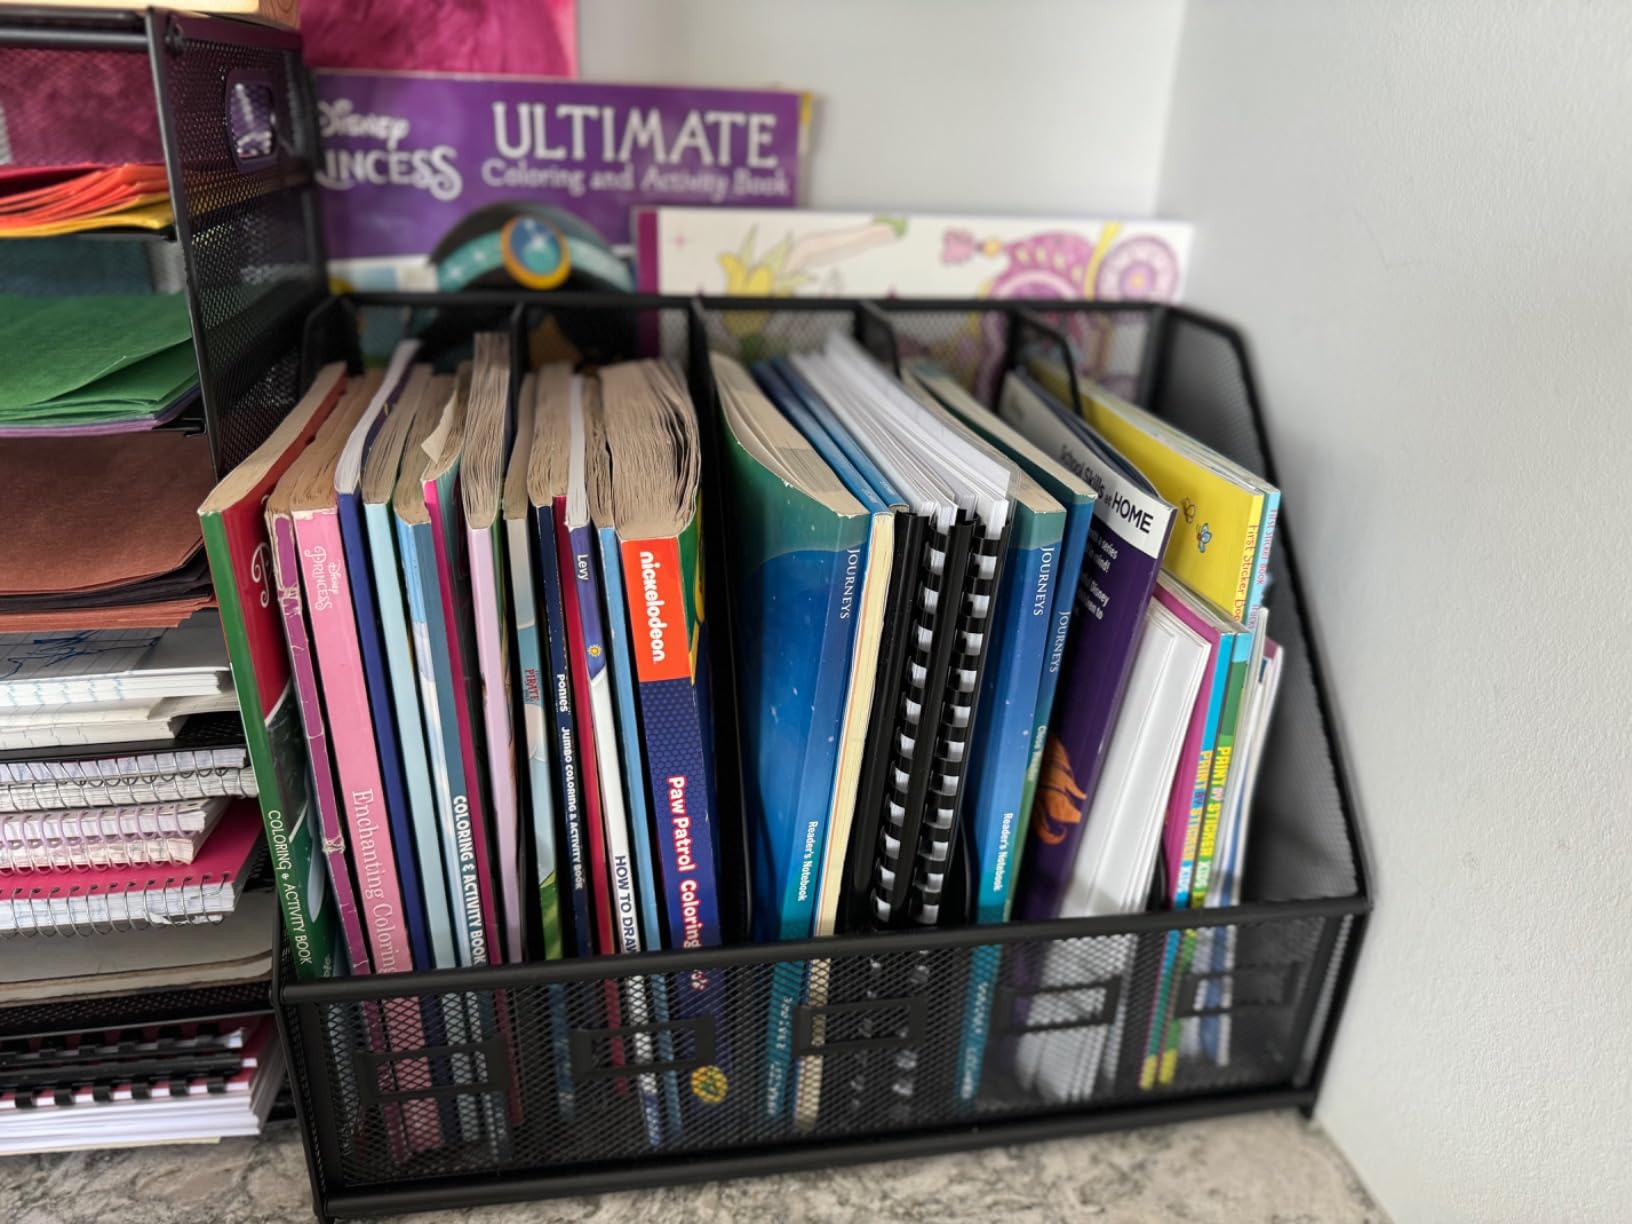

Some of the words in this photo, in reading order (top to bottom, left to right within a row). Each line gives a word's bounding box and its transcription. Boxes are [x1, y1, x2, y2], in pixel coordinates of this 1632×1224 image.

[492, 102, 778, 168] ULTIMATE
[314, 145, 463, 202] INCESS
[481, 158, 586, 196] Coloring
[590, 161, 635, 191] and
[640, 166, 728, 203] Activity
[732, 168, 790, 197] Book
[1112, 491, 1154, 534] HOME
[1244, 524, 1260, 550] First
[303, 545, 333, 612] PRINCESS
[577, 553, 590, 581] Levy
[839, 547, 860, 621] JOURNEYS
[1033, 547, 1055, 617] JOURNEYS
[1236, 554, 1255, 596] Sticker
[639, 550, 669, 663] nickelodeon
[1231, 599, 1246, 622] Boo
[1049, 610, 1070, 675] JOURNEYS
[1212, 745, 1232, 786] PRINT
[668, 775, 688, 814] Paw
[352, 788, 385, 900] Enchanting
[453, 795, 473, 862] COLORING
[570, 821, 581, 863] ACTIVITY
[671, 814, 697, 873] Patrol
[804, 820, 818, 860] Reader's
[1000, 812, 1013, 851] Reader's
[1199, 802, 1222, 857] STICKER
[267, 809, 292, 871] COLORING
[283, 882, 304, 932] ACTIVITY
[295, 933, 313, 965] BOOK
[573, 863, 585, 890] BOOK
[614, 855, 631, 892] HOW
[797, 860, 814, 902] Notebook
[993, 851, 1009, 892] Notebook
[463, 873, 482, 927] ACTIVITY
[619, 892, 633, 914] TO
[678, 879, 703, 950] Coloring
[471, 930, 487, 965] BOOK
